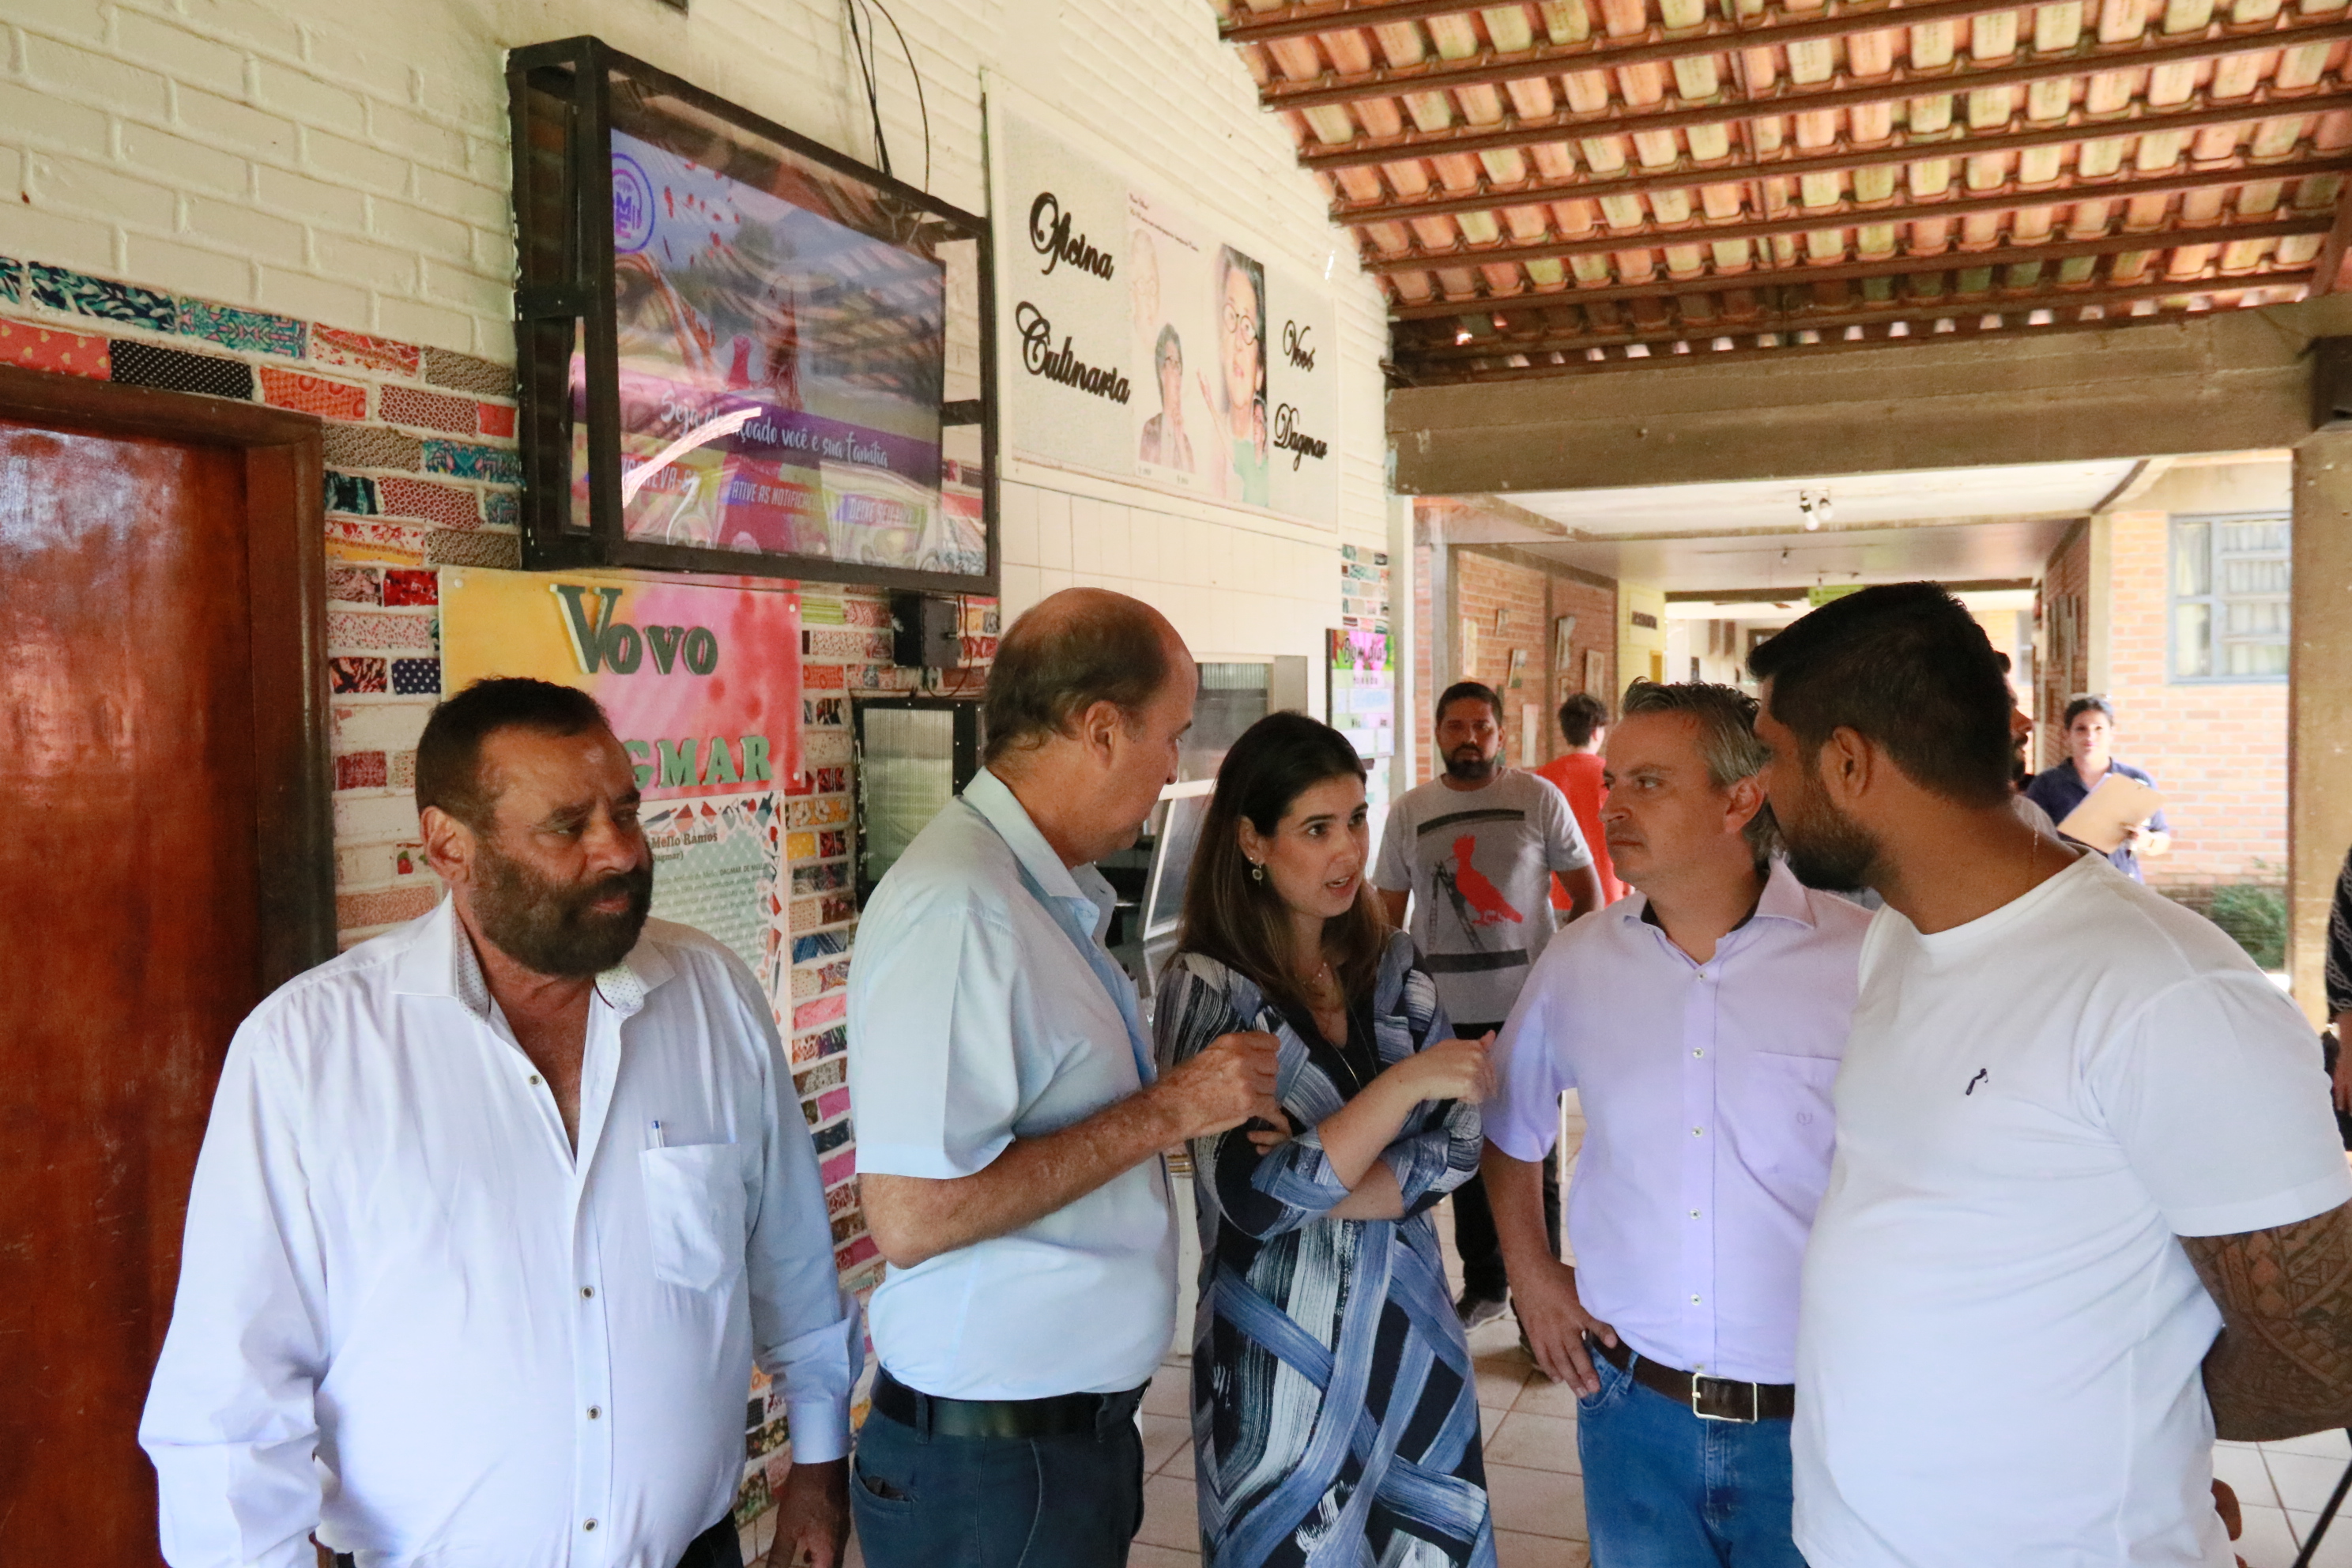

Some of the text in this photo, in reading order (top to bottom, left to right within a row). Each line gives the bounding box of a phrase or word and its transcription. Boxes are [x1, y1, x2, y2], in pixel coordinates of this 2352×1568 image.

[660, 389, 700, 438] Seja
[782, 428, 808, 449] você
[812, 435, 820, 452] e
[822, 437, 843, 459] sua
[1273, 402, 1328, 472] Dagmar
[731, 480, 758, 502] ATIVE
[758, 484, 771, 504] AS
[848, 497, 875, 522] DEIXE
[624, 735, 774, 791] GMAR
[651, 832, 718, 849] Mello Ramos
[719, 866, 742, 876] DAGMAR
